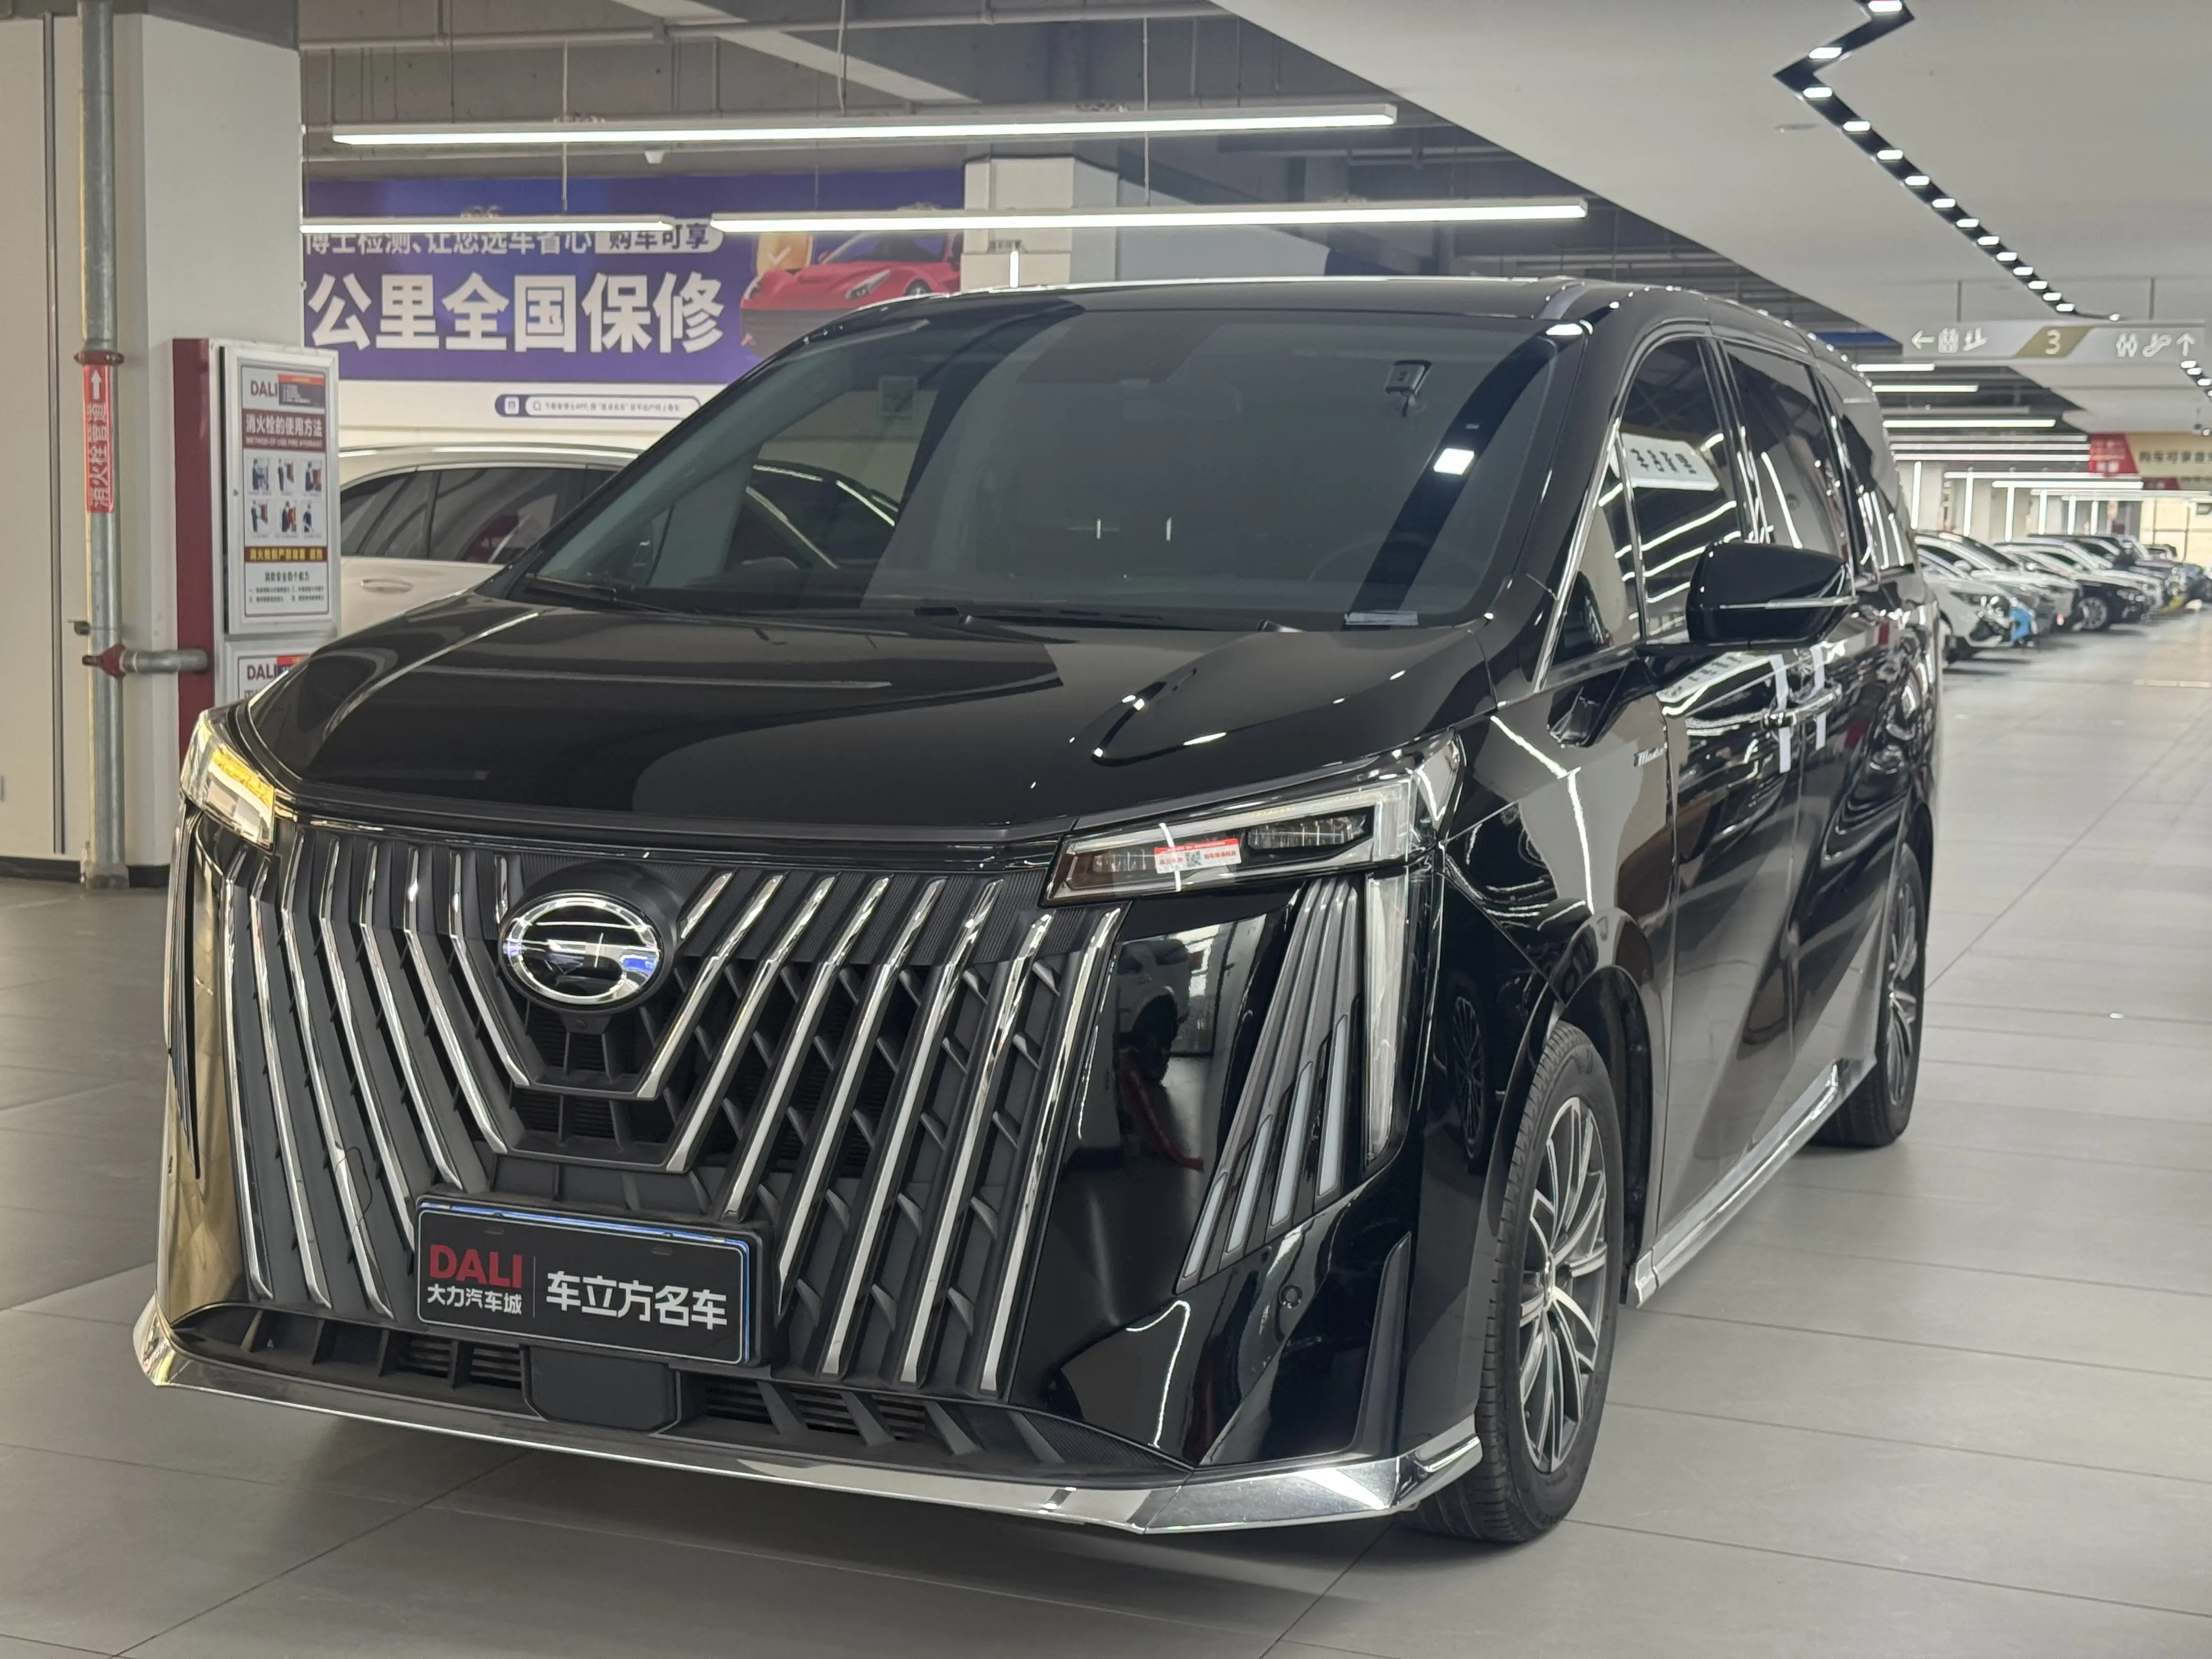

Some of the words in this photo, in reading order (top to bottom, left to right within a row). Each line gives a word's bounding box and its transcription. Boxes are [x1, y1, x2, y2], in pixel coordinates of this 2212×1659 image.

[308, 272, 724, 353] 公里全国保修
[2045, 329, 2061, 355] 3
[430, 1244, 523, 1289] DALI
[427, 1283, 522, 1316] 大力汽车城
[546, 1271, 728, 1330] 车立方名车
